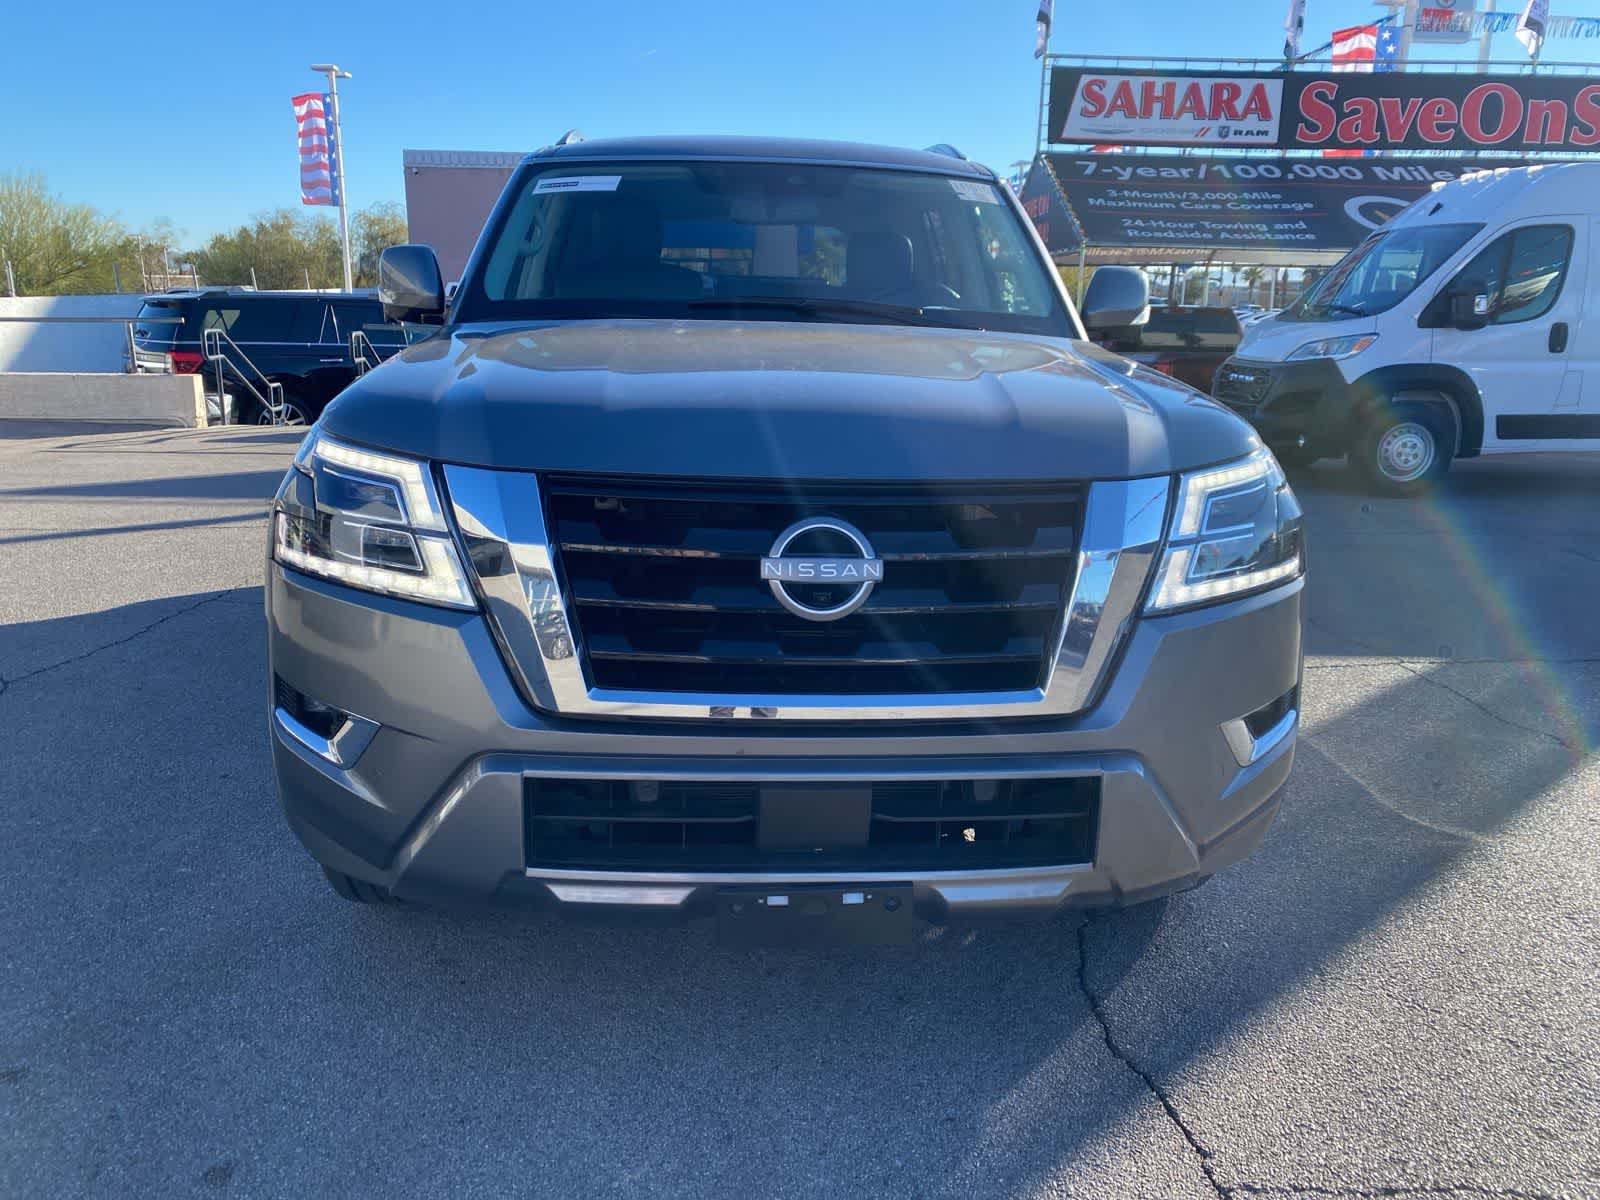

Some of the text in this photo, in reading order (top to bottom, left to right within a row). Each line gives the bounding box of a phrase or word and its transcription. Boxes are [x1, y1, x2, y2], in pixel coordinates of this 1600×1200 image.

[1080, 79, 1272, 121] SAHARA
[1232, 129, 1269, 137] RAM
[1371, 165, 1456, 182] Mile
[1088, 198, 1314, 211] Maximum Care Coverage
[1122, 218, 1307, 231] 24-Hour Towing and
[1127, 229, 1316, 240] Roadside Assistance
[765, 562, 879, 577] NISSAN
